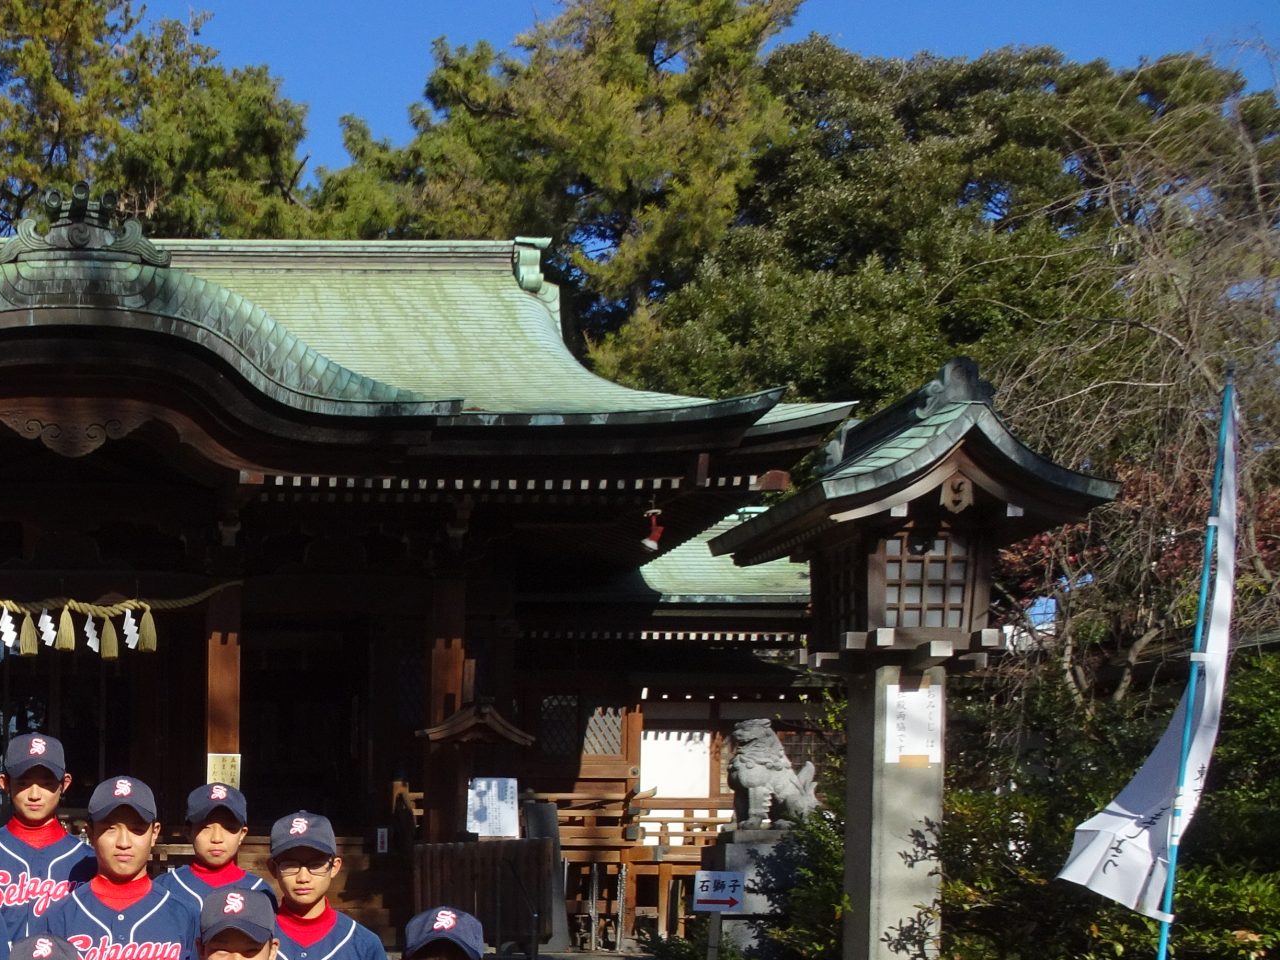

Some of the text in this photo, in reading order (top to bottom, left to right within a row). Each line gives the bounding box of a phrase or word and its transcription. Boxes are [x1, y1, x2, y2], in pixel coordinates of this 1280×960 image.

[30, 738, 47, 755] S
[113, 779, 132, 796] S
[211, 785, 228, 799] S
[290, 818, 308, 835] S
[224, 892, 245, 915] S
[433, 911, 456, 930] S
[32, 938, 54, 960] S
